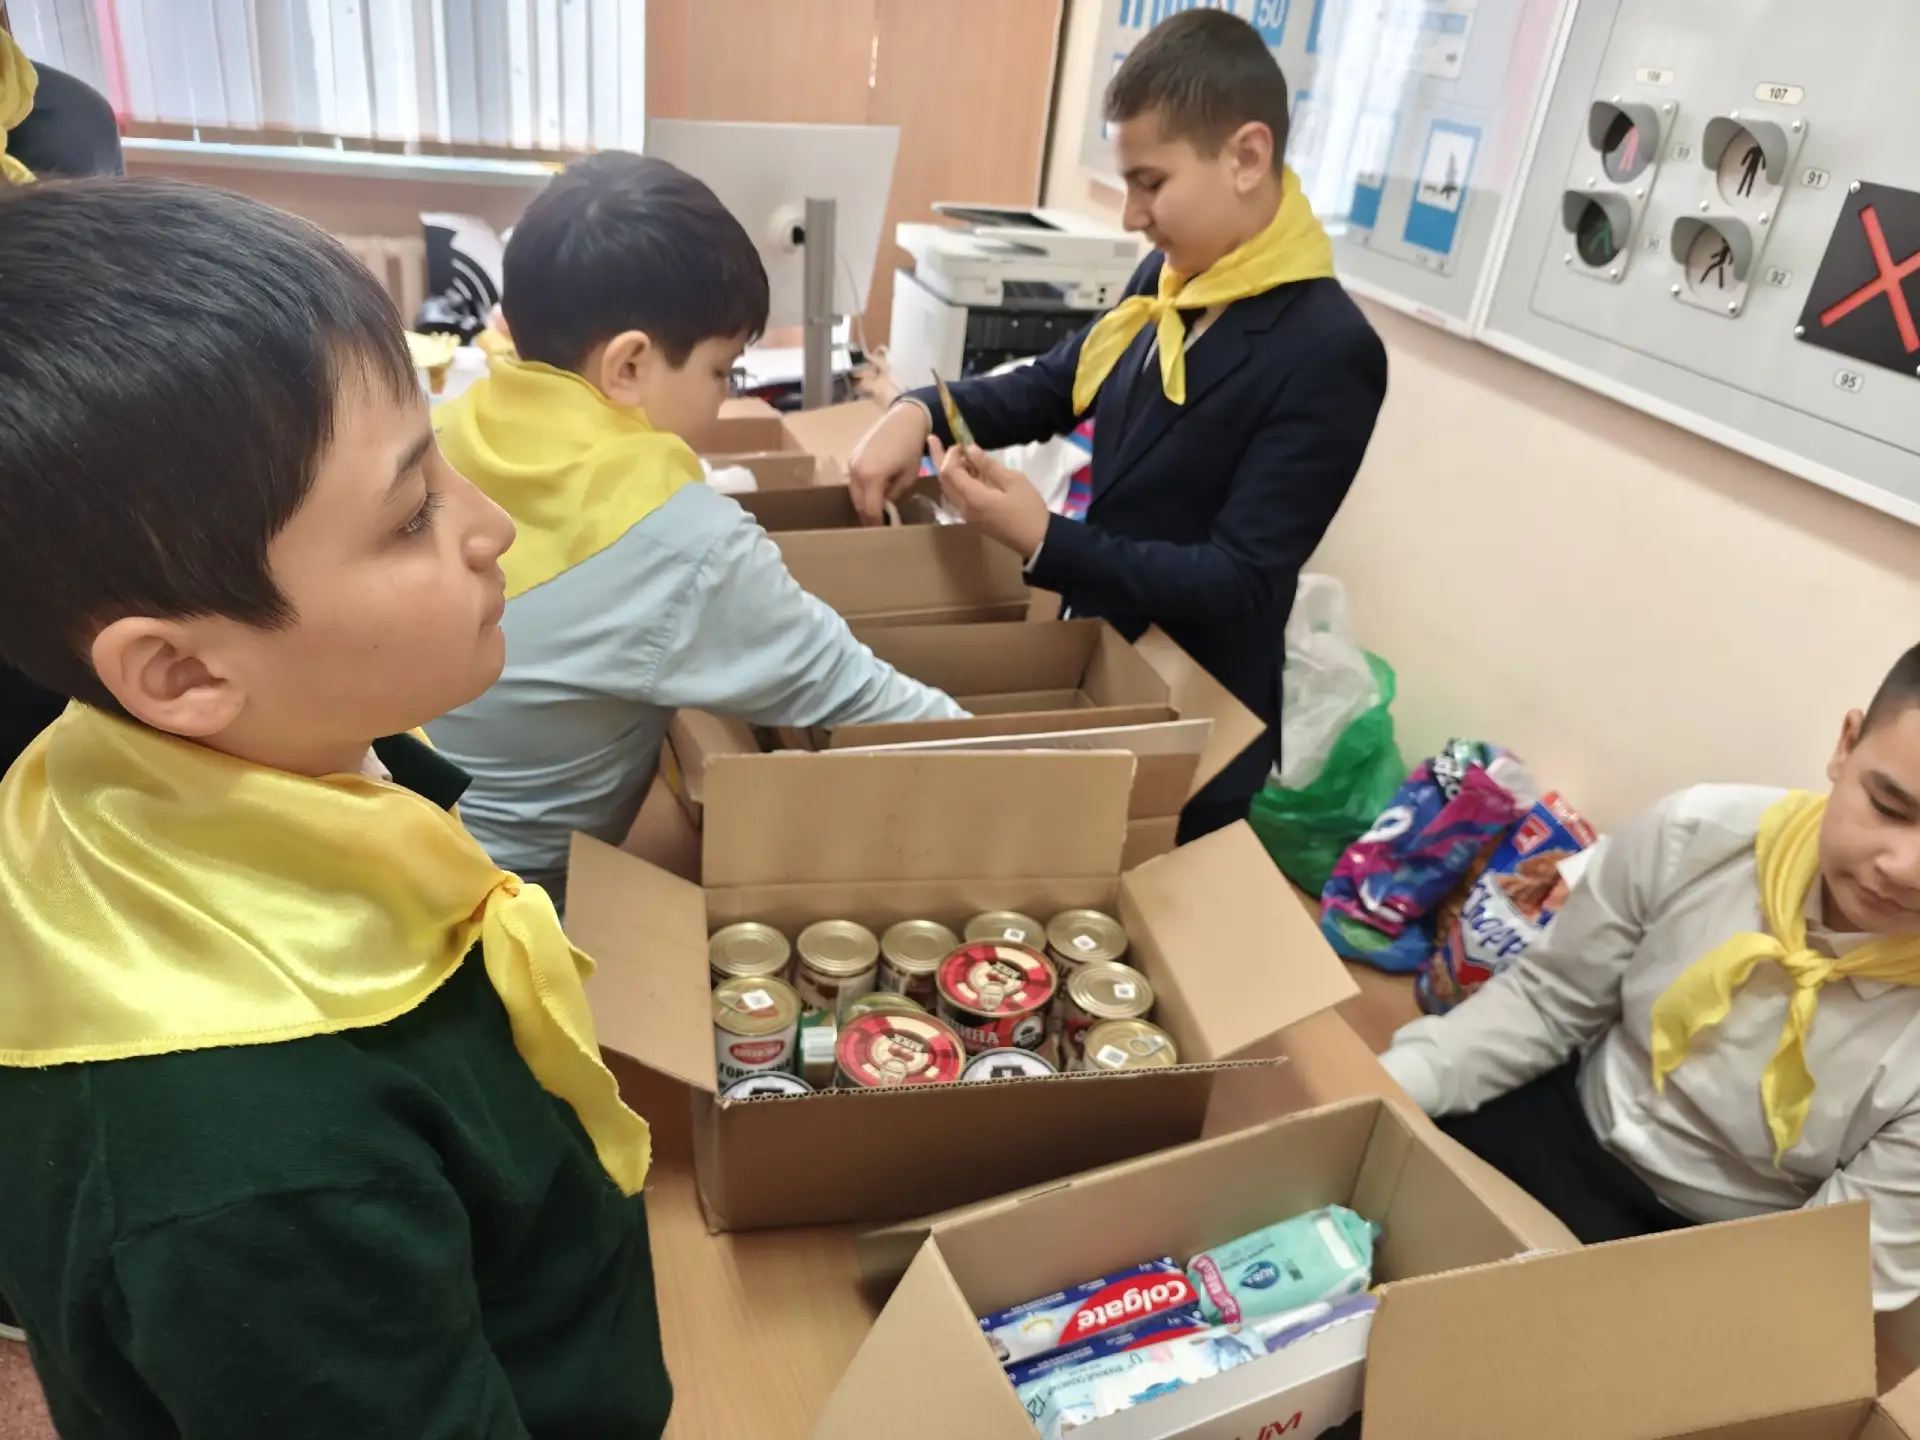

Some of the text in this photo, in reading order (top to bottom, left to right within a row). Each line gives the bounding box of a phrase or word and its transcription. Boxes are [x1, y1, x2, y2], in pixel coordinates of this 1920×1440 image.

[1257, 0, 1286, 28] 50
[1769, 87, 1788, 100] 107
[1808, 170, 1822, 185] 91
[1771, 270, 1787, 284] 92
[1840, 373, 1857, 388] 95
[1076, 1279, 1189, 1330] Colgate
